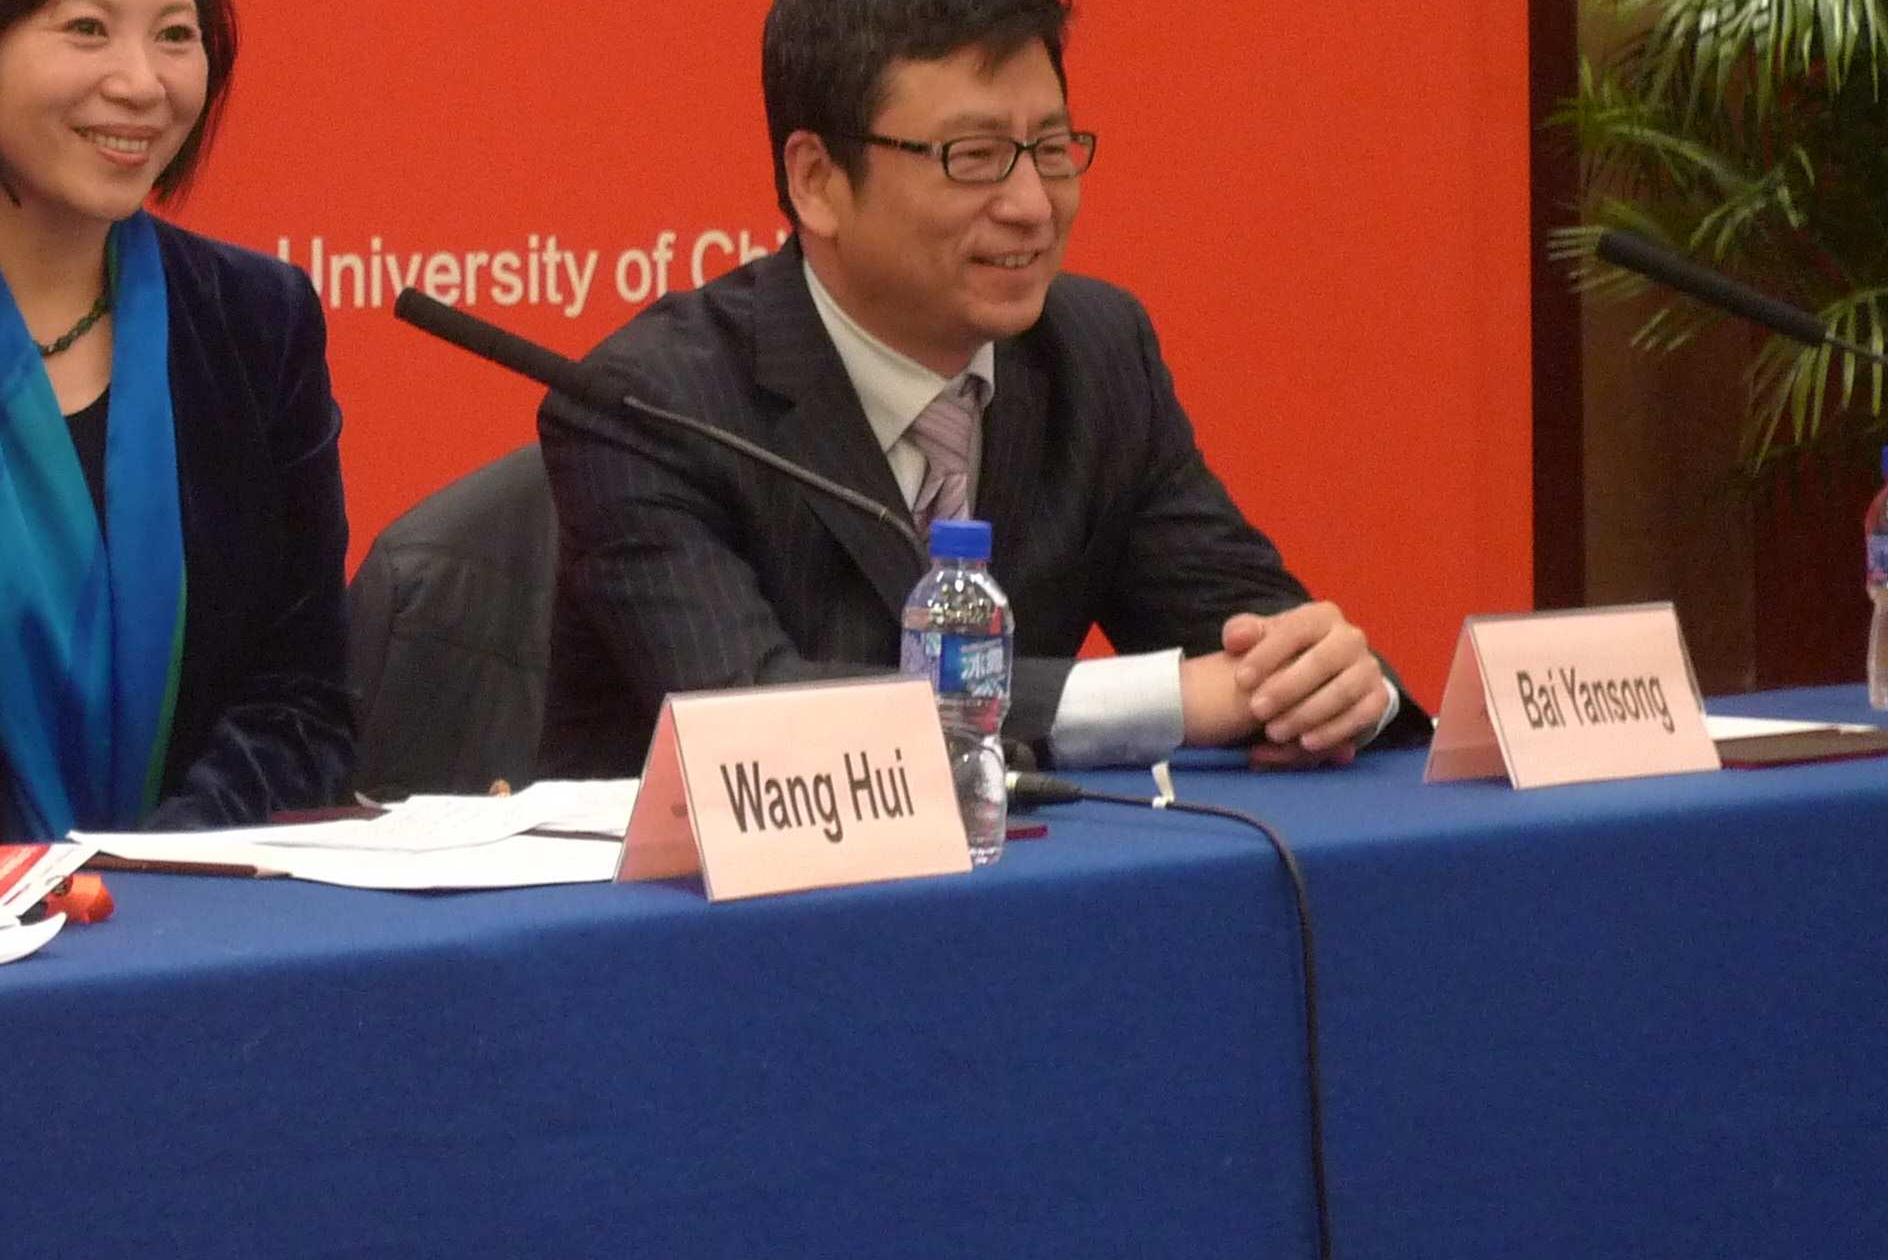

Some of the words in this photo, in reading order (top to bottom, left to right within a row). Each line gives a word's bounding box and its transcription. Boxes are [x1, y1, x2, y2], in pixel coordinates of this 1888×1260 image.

[277, 233, 598, 318] University
[615, 229, 677, 303] of
[1516, 668, 1566, 730] Bai
[1559, 666, 1676, 734] Yansong
[720, 761, 843, 843] Wang
[843, 748, 915, 821] Hui
